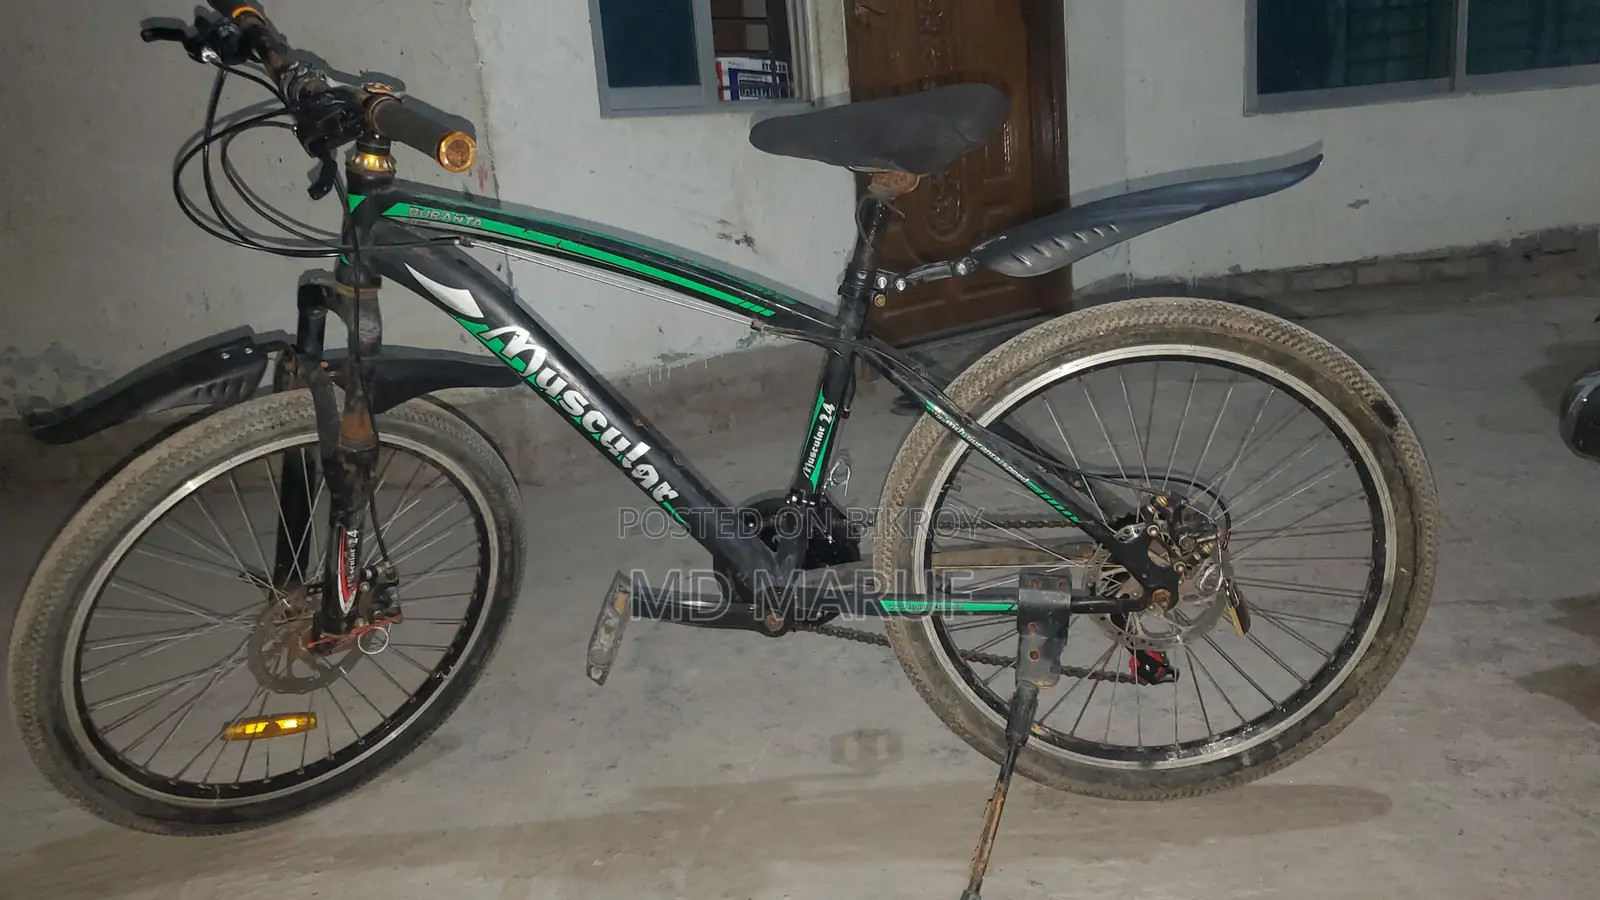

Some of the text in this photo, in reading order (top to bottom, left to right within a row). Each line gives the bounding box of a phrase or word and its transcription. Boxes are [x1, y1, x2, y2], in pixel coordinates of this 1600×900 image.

[408, 207, 482, 229] DURANTA
[478, 325, 679, 502] Muscular
[803, 403, 835, 478] Muscular 24
[1003, 462, 1029, 482] speed
